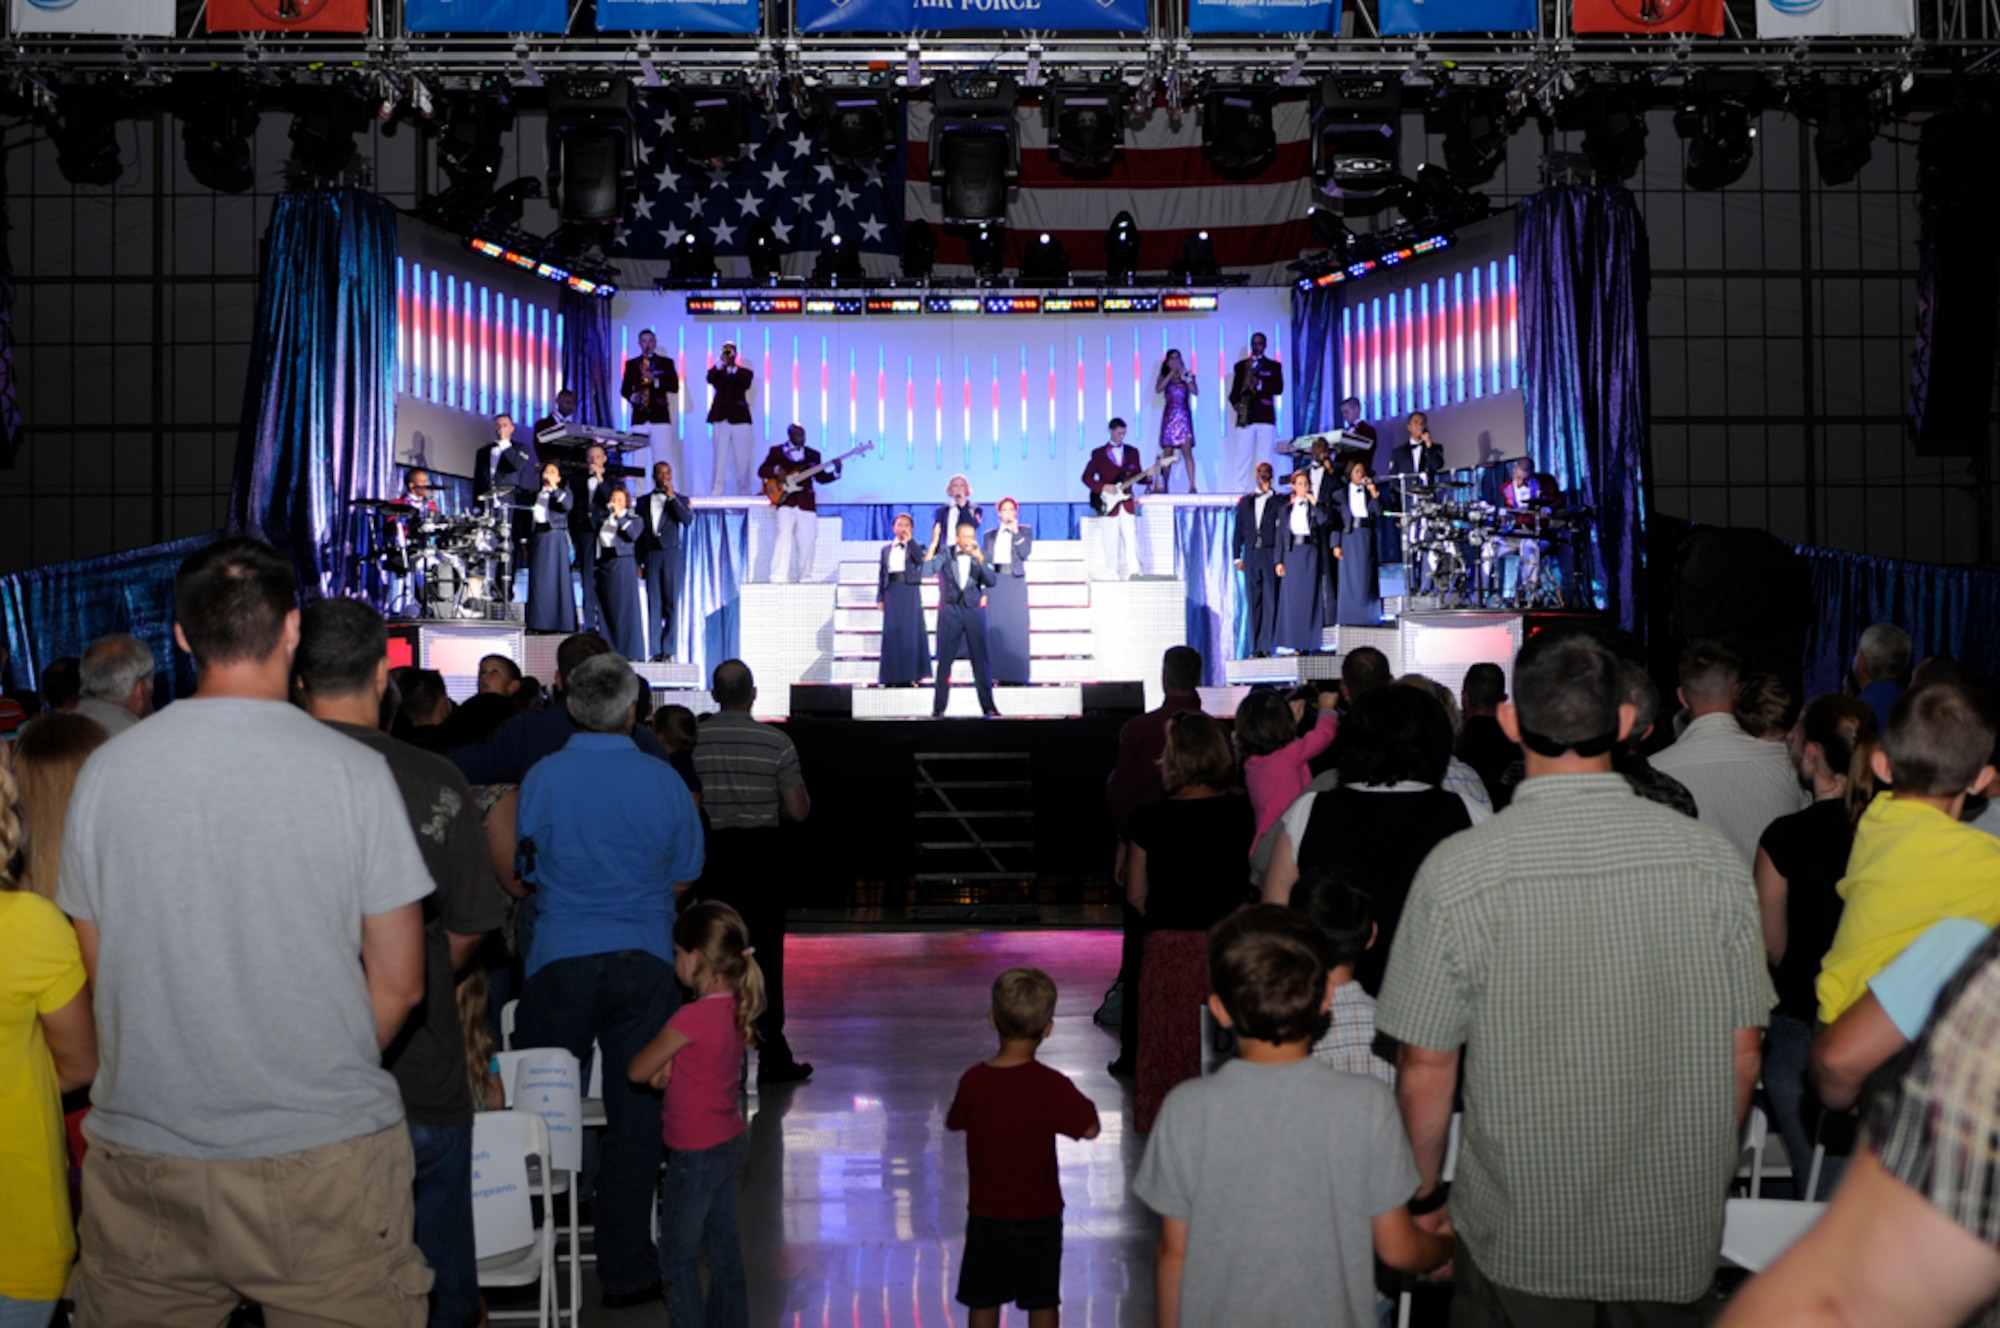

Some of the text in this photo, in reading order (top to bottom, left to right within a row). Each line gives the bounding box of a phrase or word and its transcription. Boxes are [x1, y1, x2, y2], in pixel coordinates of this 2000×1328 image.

[528, 1067, 567, 1077] Honorary
[522, 1080, 574, 1090] Commanders
[472, 1183, 517, 1199] ergeants
